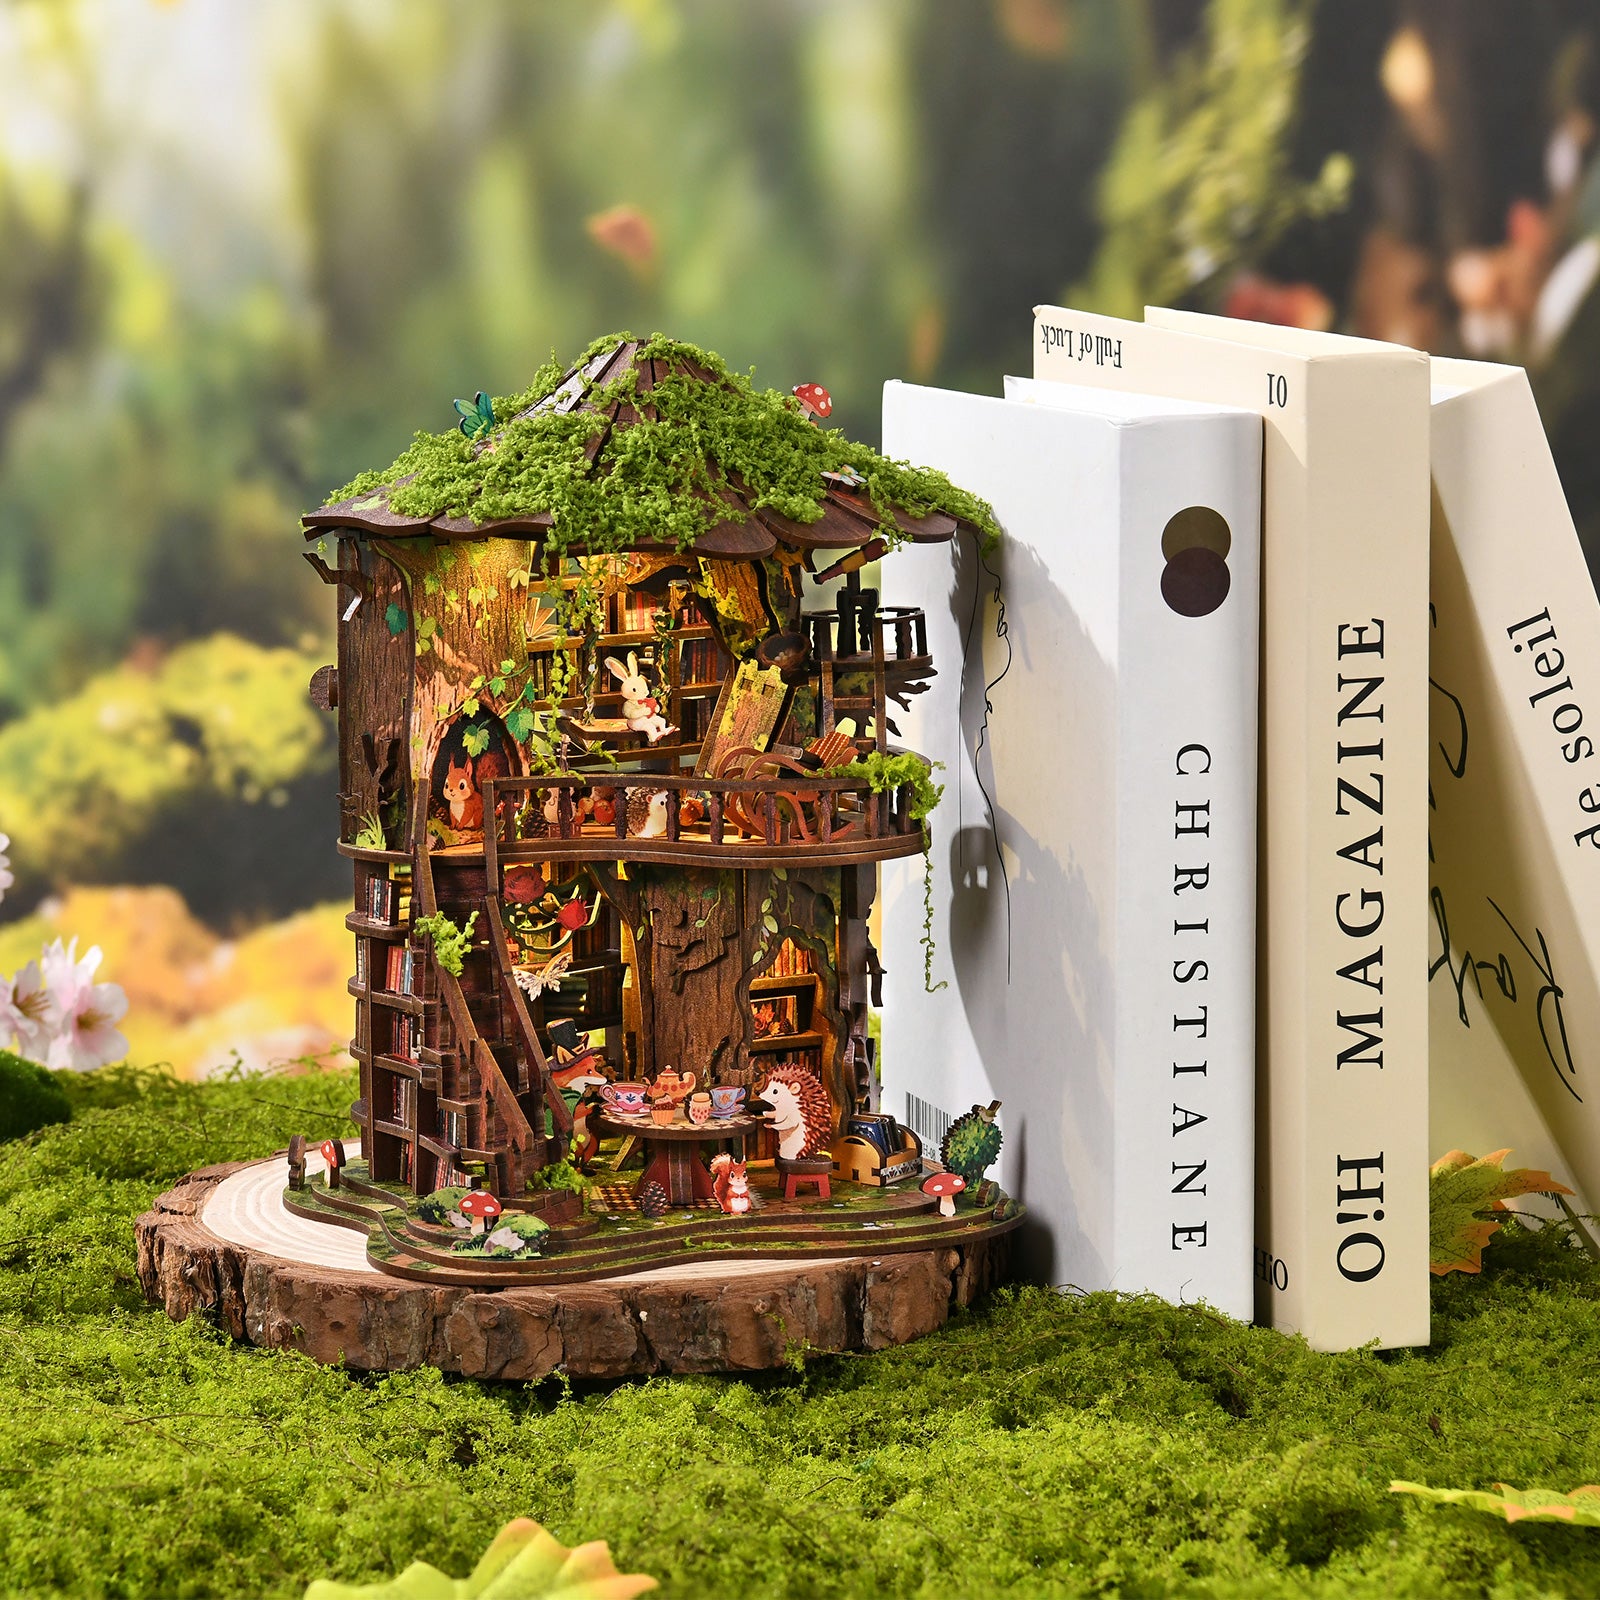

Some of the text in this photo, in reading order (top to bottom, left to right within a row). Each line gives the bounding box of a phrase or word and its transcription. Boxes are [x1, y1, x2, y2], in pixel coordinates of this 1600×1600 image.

[1041, 324, 1122, 369] Full of Luck
[1266, 373, 1288, 408] 01
[1506, 606, 1595, 764] soleil
[1171, 743, 1212, 1251] CHRISTIANE
[1336, 617, 1386, 1283] O!H MAGAZINE
